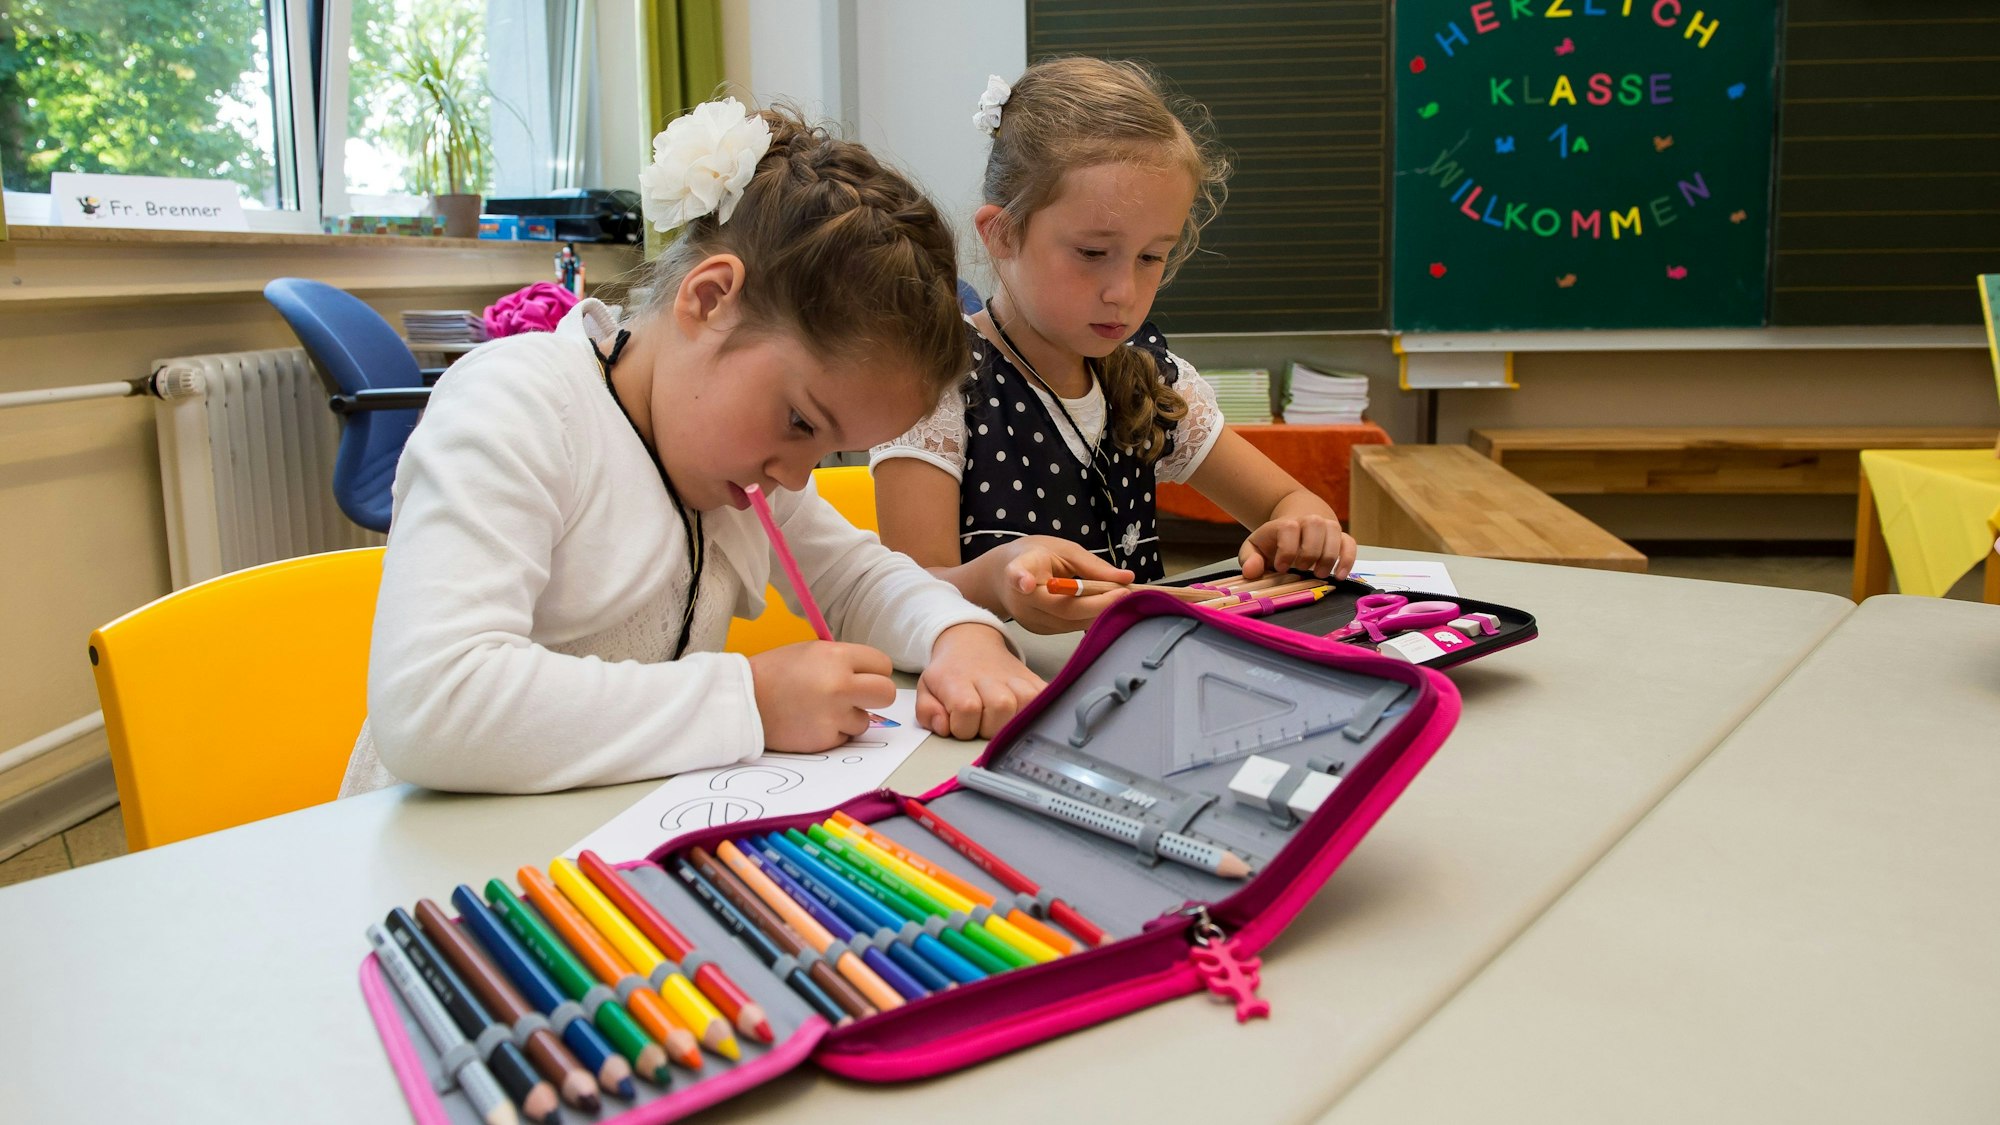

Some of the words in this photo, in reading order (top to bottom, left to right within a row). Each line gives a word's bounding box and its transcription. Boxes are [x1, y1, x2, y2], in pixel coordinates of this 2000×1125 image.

[1490, 73, 1673, 105] KLASSE
[109, 200, 139, 217] Fr.
[145, 201, 222, 217] Brenner
[1428, 149, 1710, 240] WILLKOMMEN
